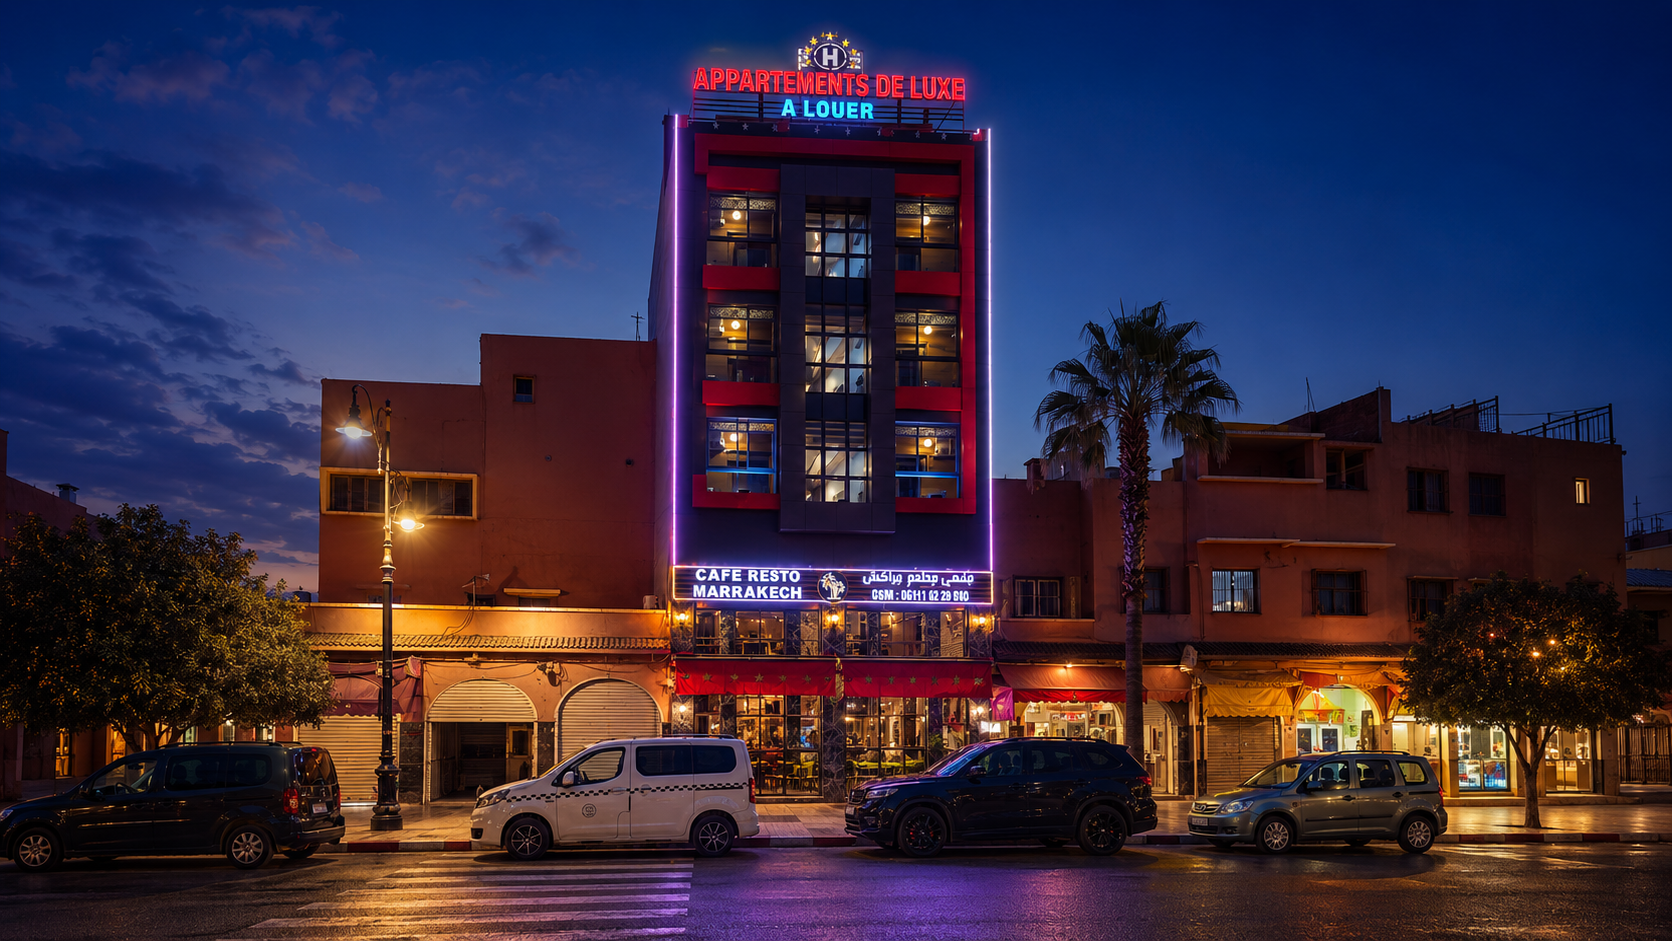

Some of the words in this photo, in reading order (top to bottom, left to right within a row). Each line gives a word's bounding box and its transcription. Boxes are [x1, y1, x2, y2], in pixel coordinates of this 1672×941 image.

[822, 48, 838, 67] H
[693, 67, 869, 97] APPARTEMENTS
[876, 74, 904, 98] DE
[911, 75, 965, 101] LUXE
[781, 98, 797, 117] A
[803, 100, 874, 119] LOUER
[695, 568, 742, 581] CAFE
[748, 569, 801, 582] RESTO
[693, 584, 802, 599] MARRAKECH
